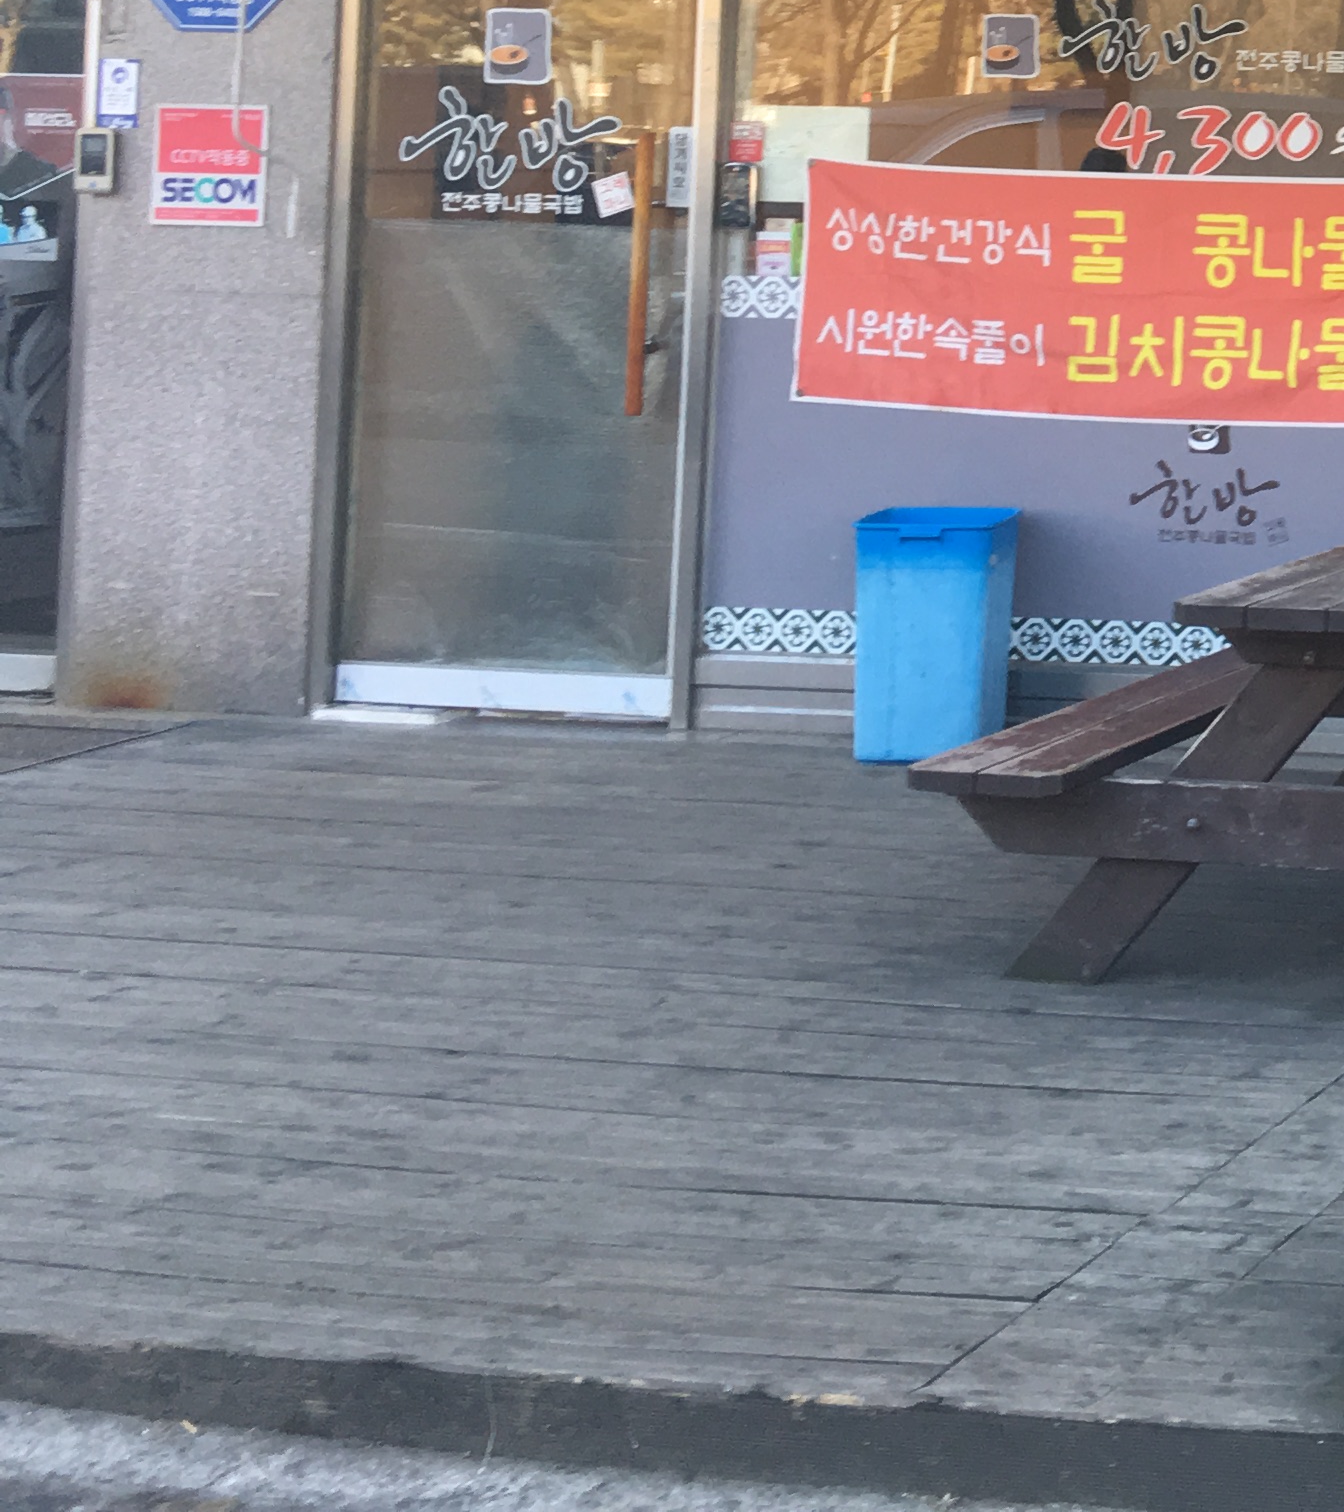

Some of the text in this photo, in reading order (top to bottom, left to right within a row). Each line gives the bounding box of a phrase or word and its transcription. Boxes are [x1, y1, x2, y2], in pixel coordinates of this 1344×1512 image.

[398, 84, 623, 193] 한방
[1094, 100, 1324, 177] 4,300
[161, 177, 258, 205] SECOM
[440, 191, 584, 216] 전주콩나물국밥
[826, 206, 1051, 267] 싱싱한건강식
[1069, 209, 1128, 285] 굴
[1128, 458, 1281, 527] 한방
